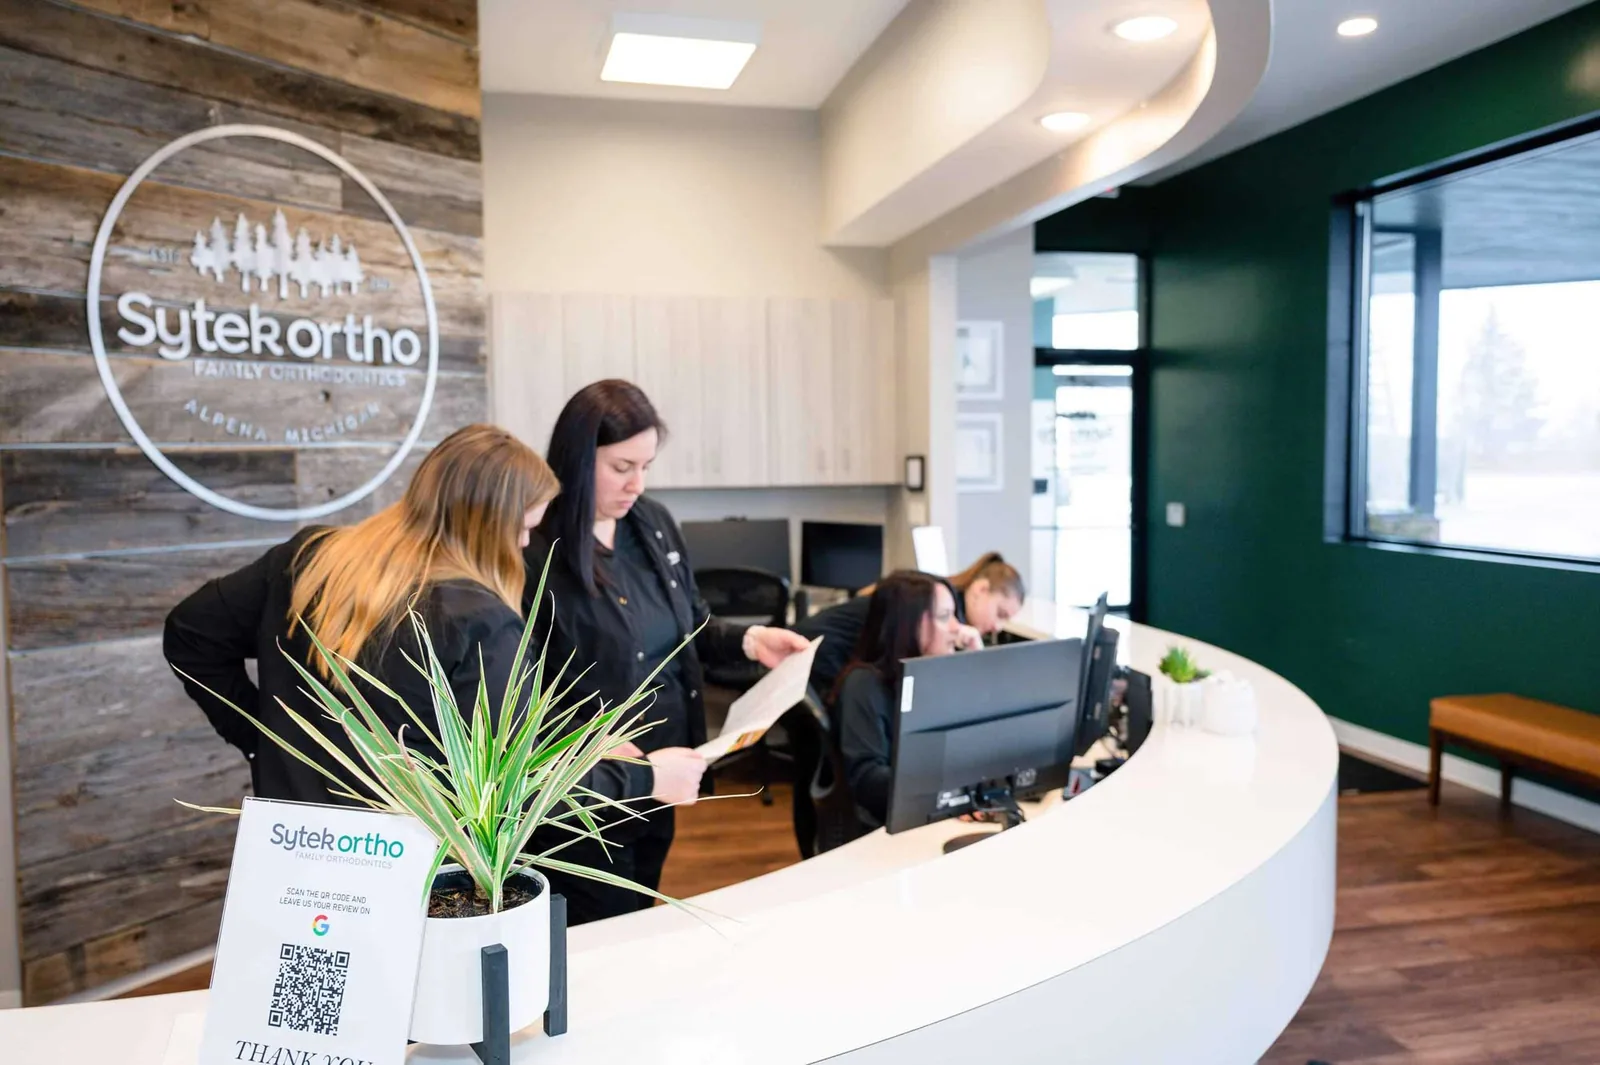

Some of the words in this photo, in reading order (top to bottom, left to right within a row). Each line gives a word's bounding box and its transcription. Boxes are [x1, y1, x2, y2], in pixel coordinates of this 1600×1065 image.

[194, 359, 264, 380] FAMILY
[269, 364, 406, 387] ORTHODONTICS
[285, 402, 381, 443] MICHIGAN
[295, 851, 325, 861] FAMILY
[326, 855, 393, 870] ORTHODONTICS
[279, 896, 301, 907] LEAVE
[302, 900, 312, 908] US
[313, 901, 331, 910] YOUR
[332, 903, 359, 913] REVIEW
[360, 906, 371, 915] ON
[286, 887, 305, 896] SCAN
[306, 889, 319, 899] THE
[320, 891, 331, 900] QR
[332, 893, 351, 902] CODE
[351, 895, 367, 904] AND
[235, 1040, 317, 1065] THANK
